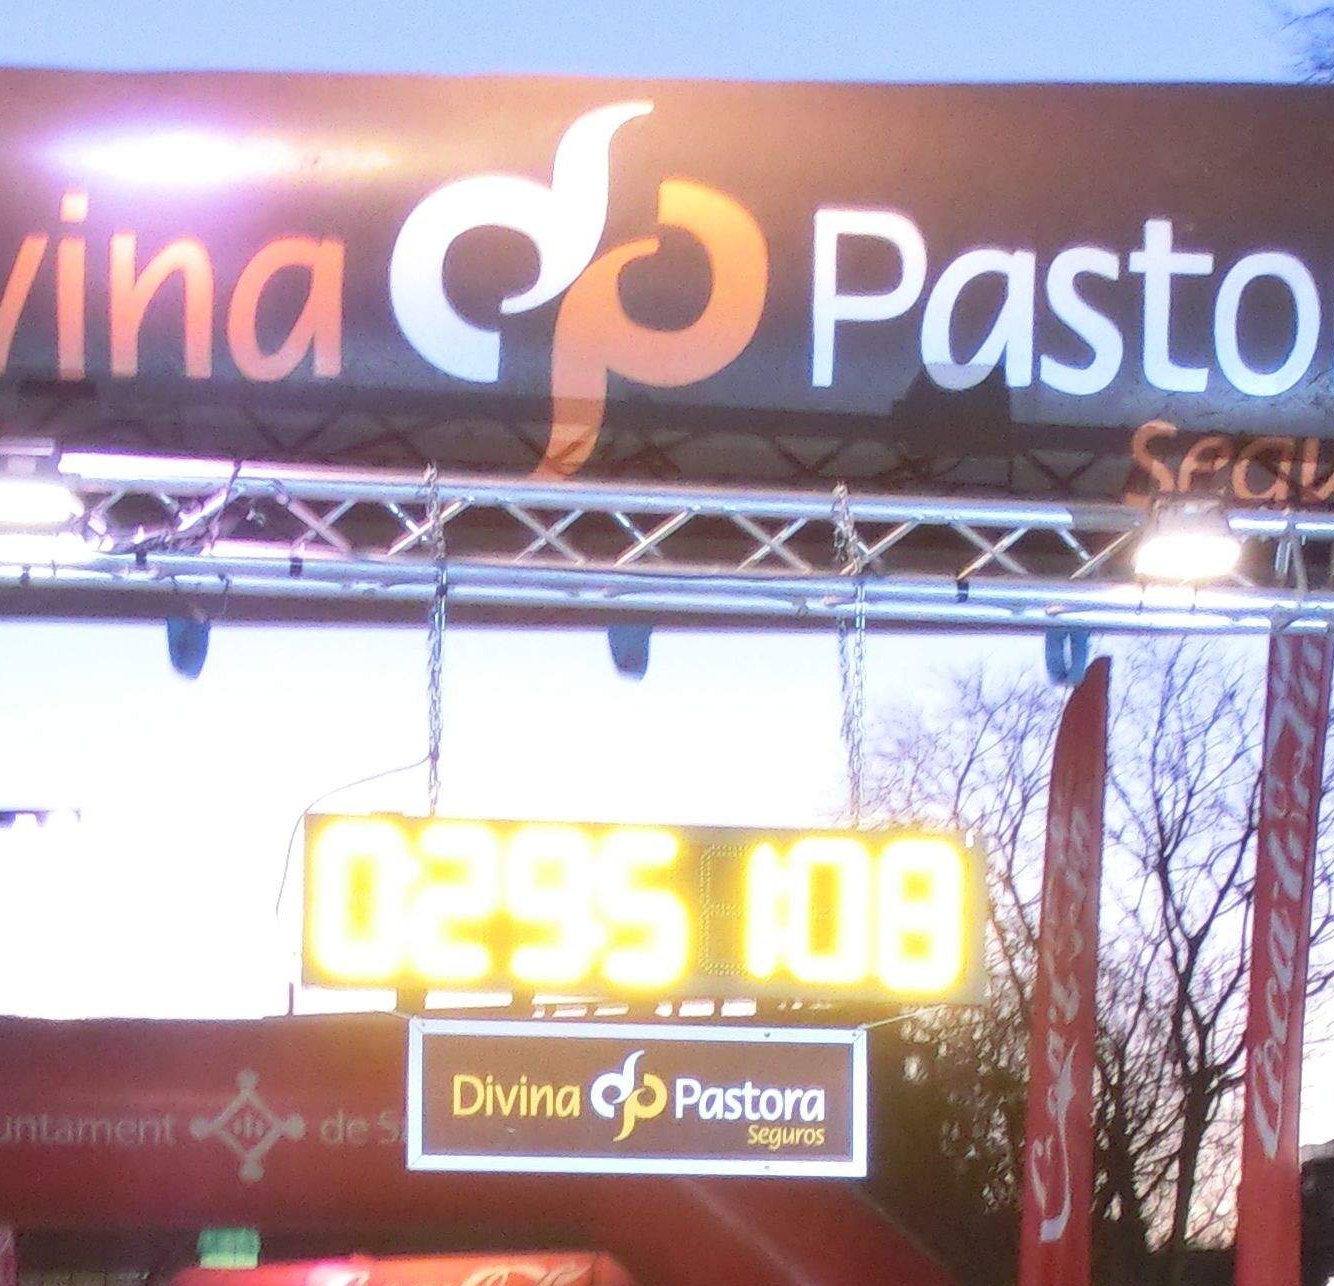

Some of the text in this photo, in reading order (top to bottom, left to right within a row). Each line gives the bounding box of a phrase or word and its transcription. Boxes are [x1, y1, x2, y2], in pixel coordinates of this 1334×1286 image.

[452, 1073, 581, 1118] Divina
[674, 1077, 827, 1122] Pastora
[319, 1110, 368, 1145] de
[746, 1123, 827, 1152] Seguros
